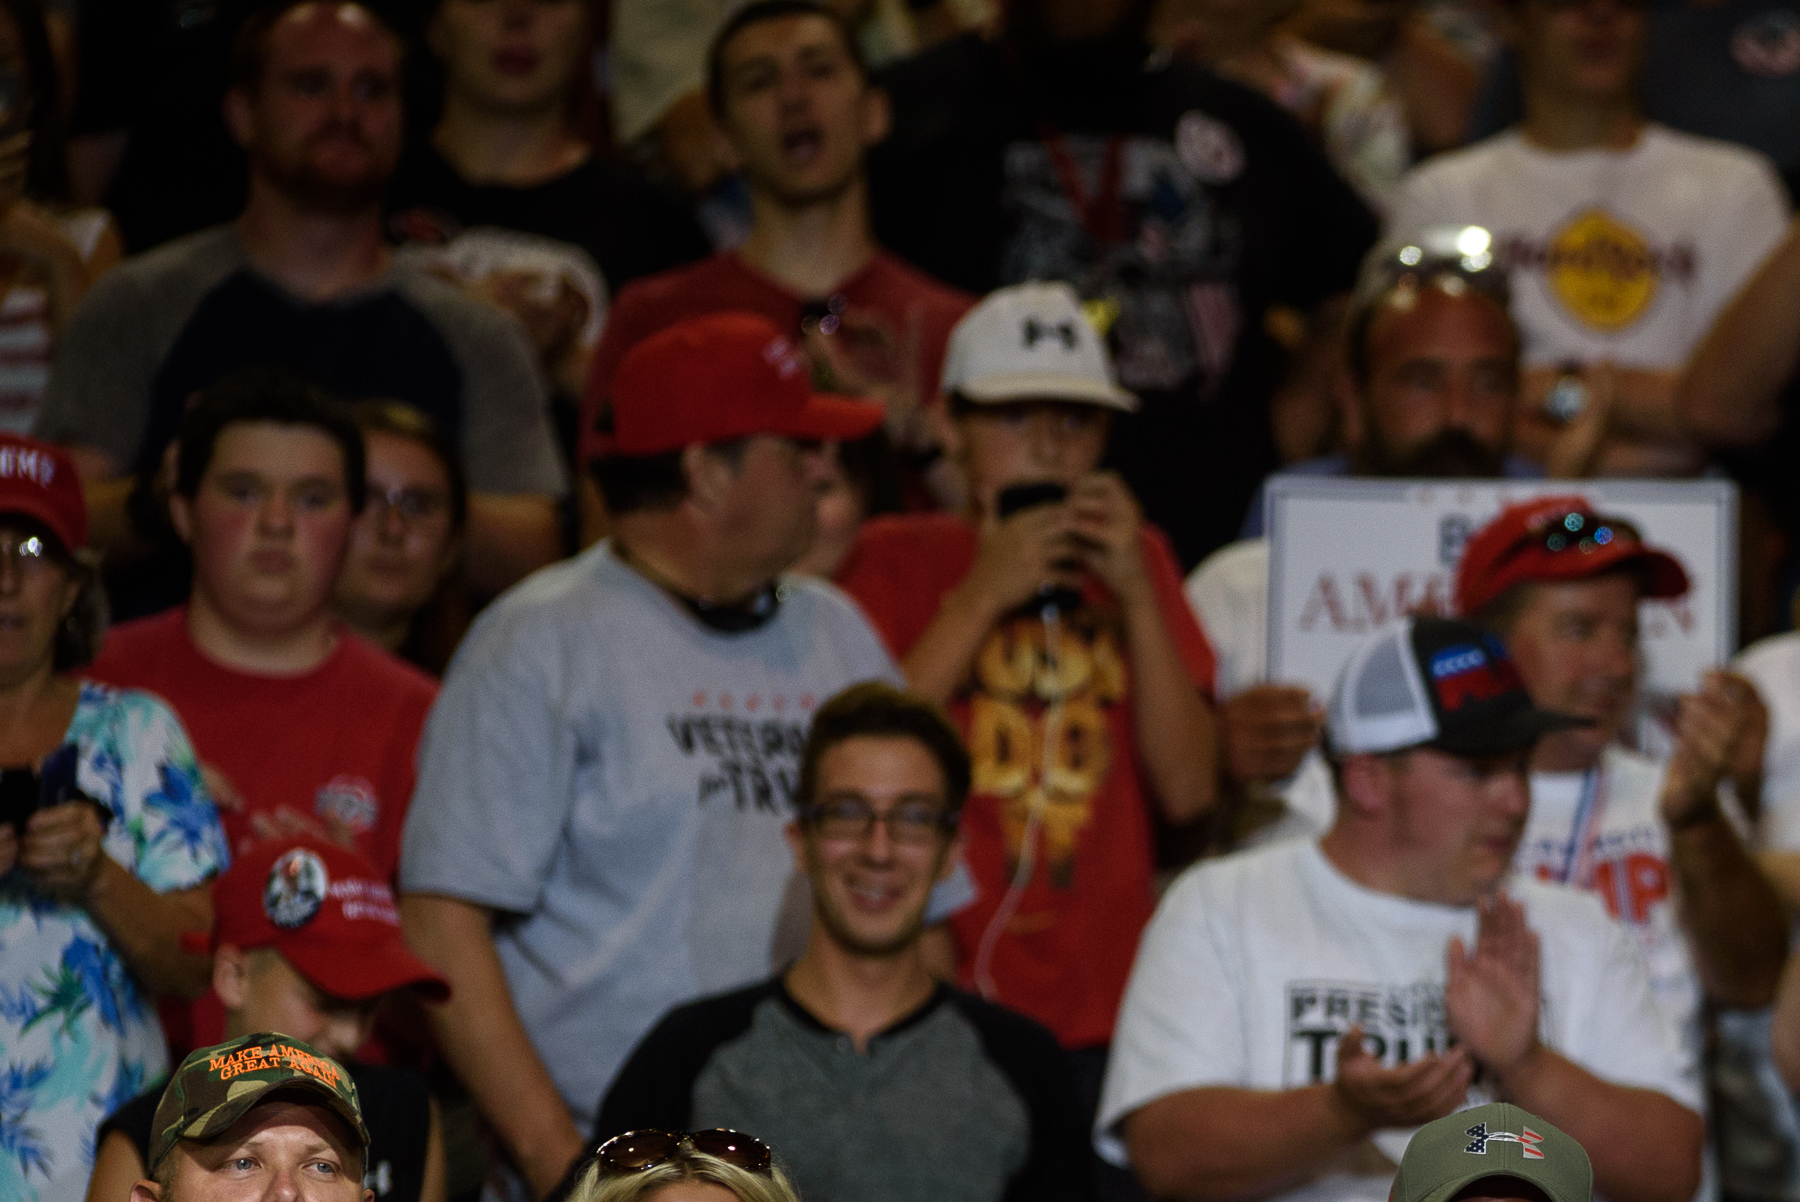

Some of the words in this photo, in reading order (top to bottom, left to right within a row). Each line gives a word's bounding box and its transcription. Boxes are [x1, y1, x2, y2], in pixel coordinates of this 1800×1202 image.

[208, 1045, 263, 1072] MAKE
[268, 1043, 341, 1082] AMERICA
[220, 1056, 281, 1081] GREAT
[289, 1058, 338, 1090] AGAIN
